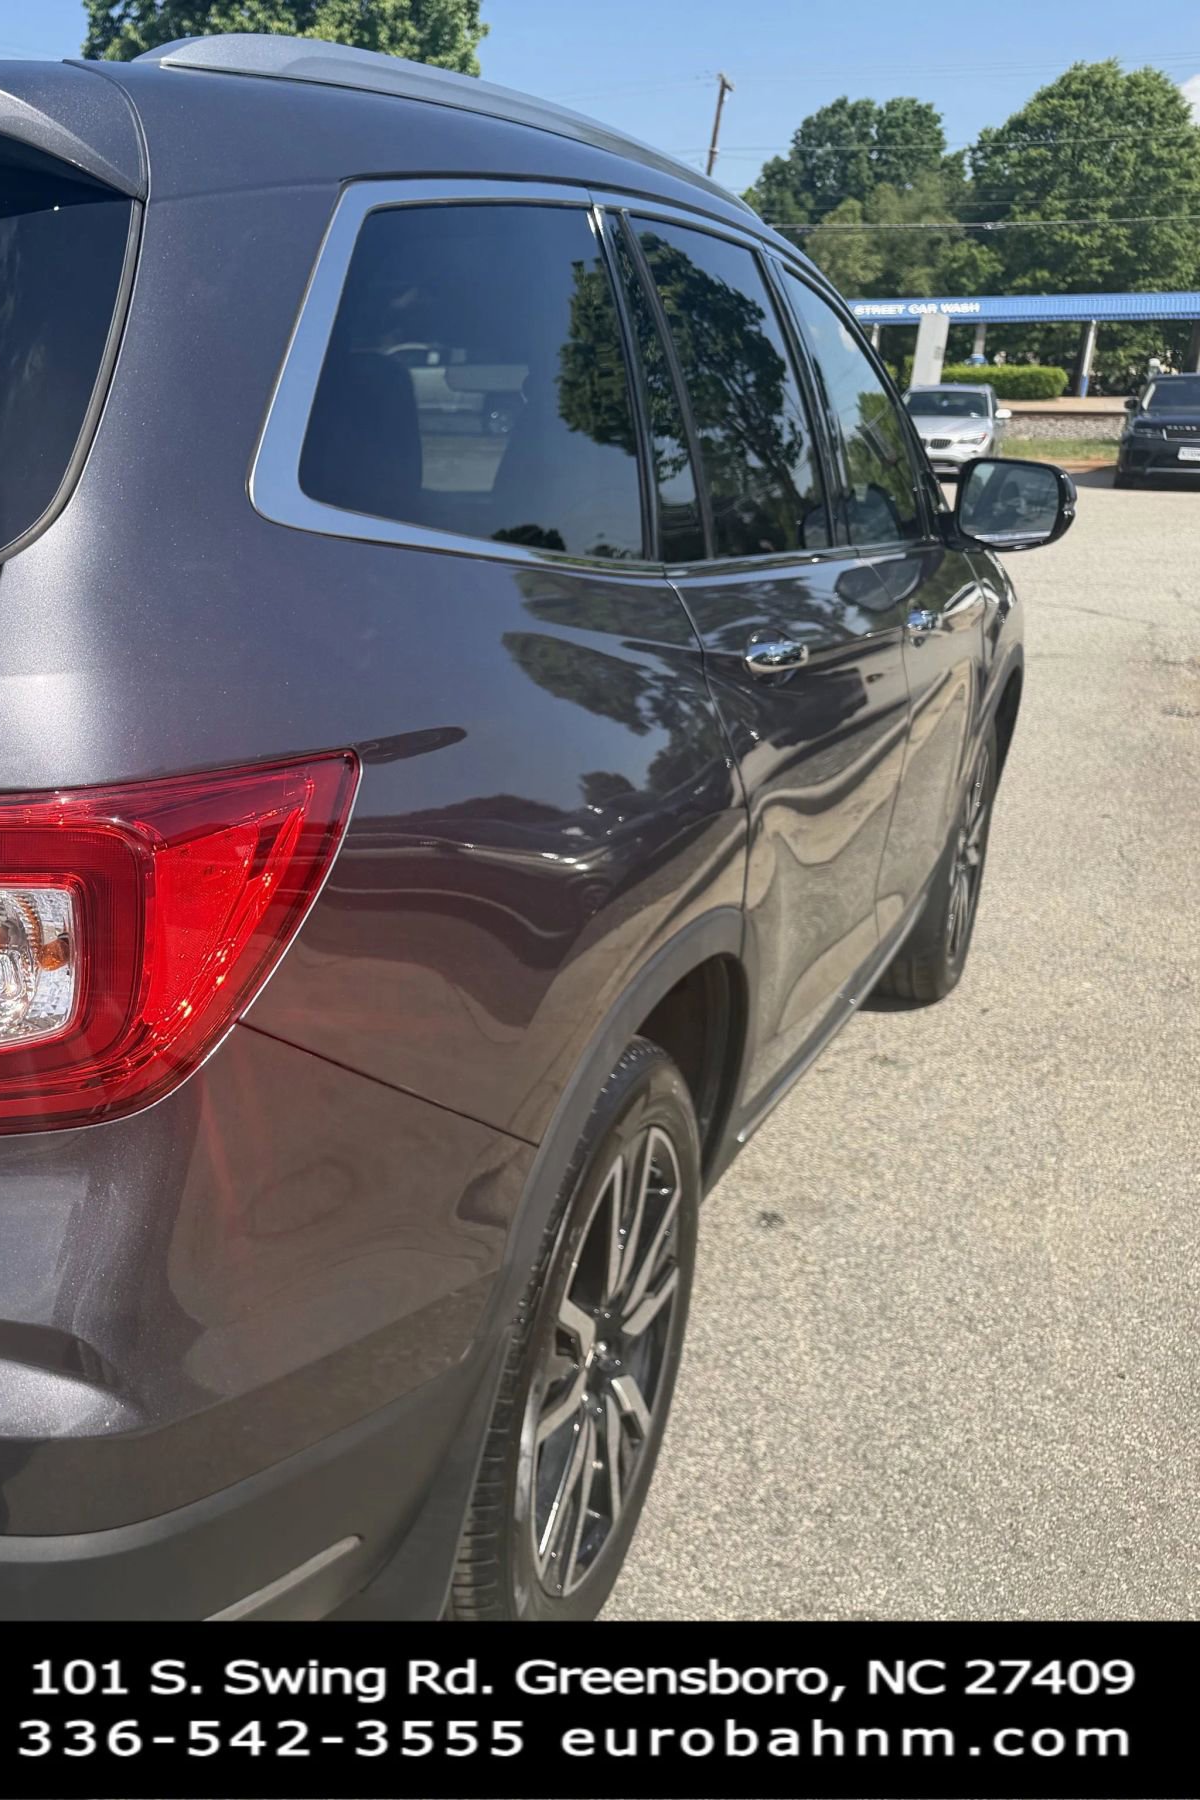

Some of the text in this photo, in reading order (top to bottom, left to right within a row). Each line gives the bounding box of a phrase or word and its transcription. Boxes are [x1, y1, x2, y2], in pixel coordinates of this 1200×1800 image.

[854, 302, 980, 315] STREET CAR WASH
